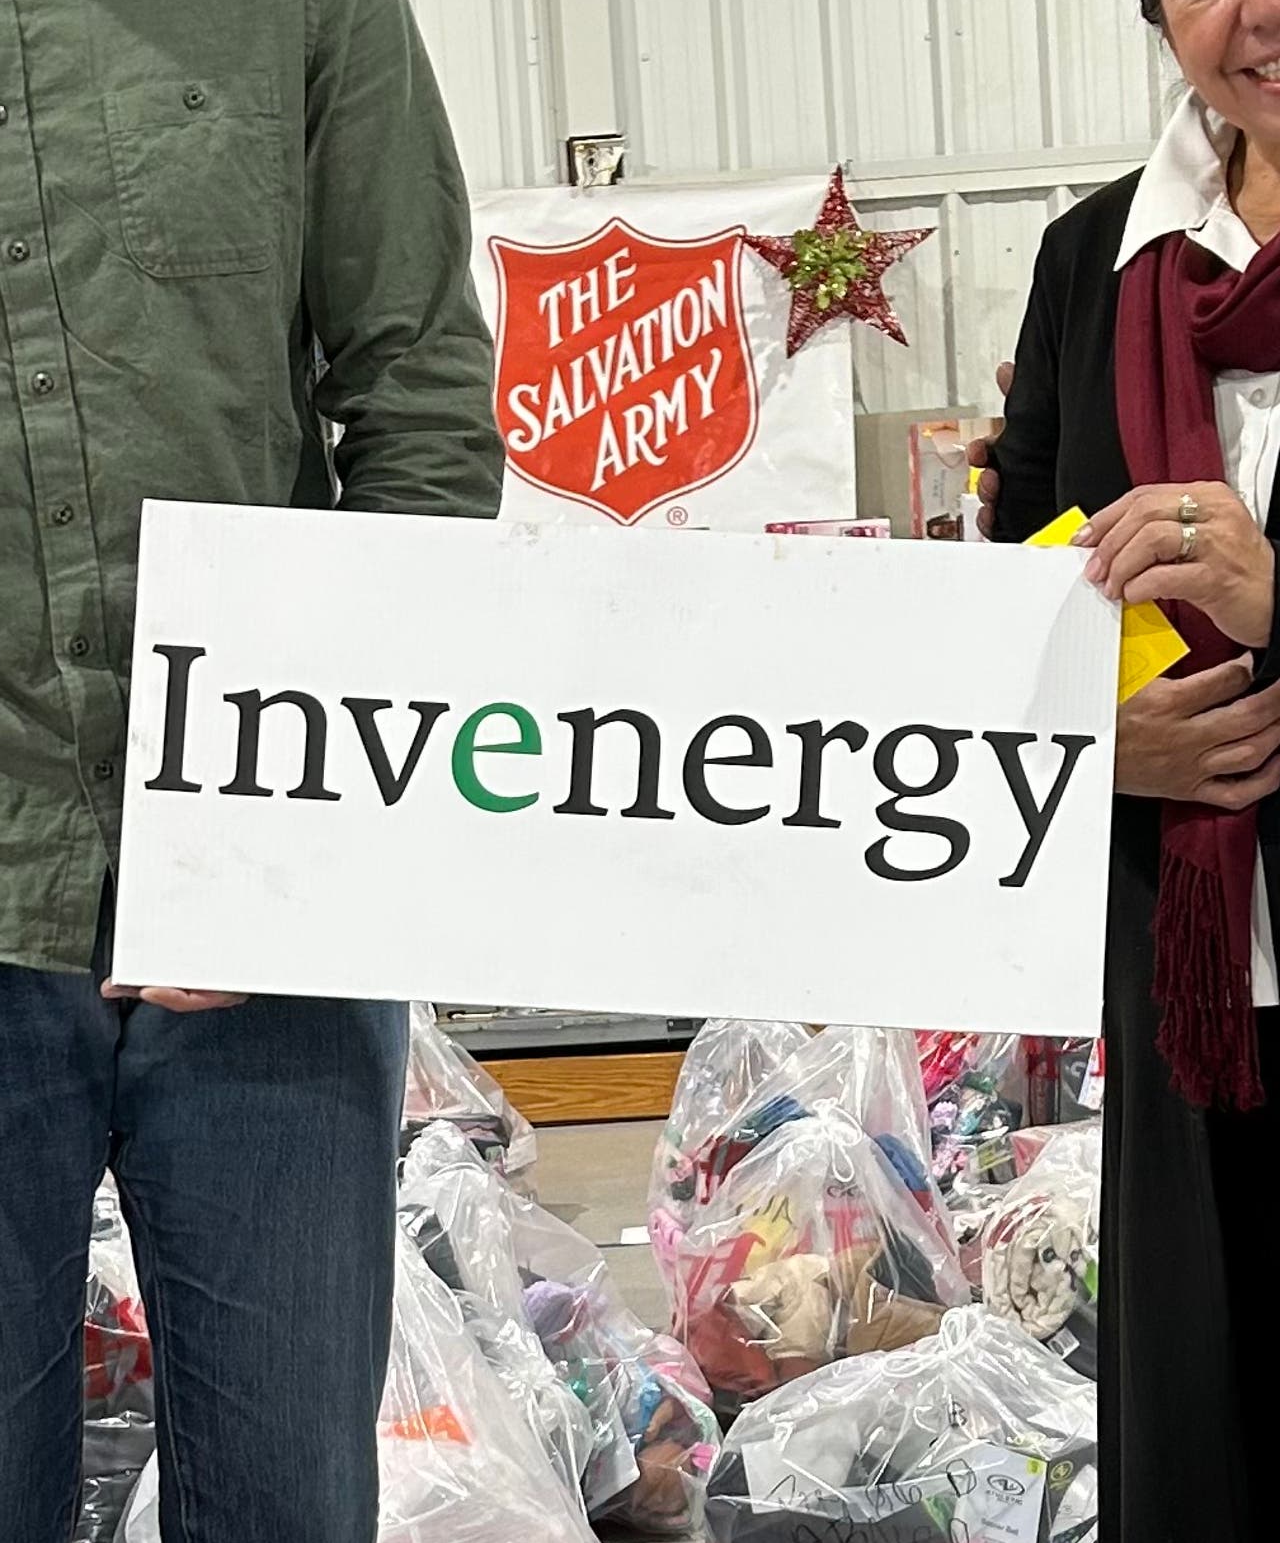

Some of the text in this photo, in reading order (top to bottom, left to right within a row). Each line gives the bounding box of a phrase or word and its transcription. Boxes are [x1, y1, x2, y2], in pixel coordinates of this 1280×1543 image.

[506, 259, 728, 453] SALVATION
[538, 246, 638, 350] THE
[589, 346, 723, 493] ARMY
[144, 642, 1097, 888] Invenergy
